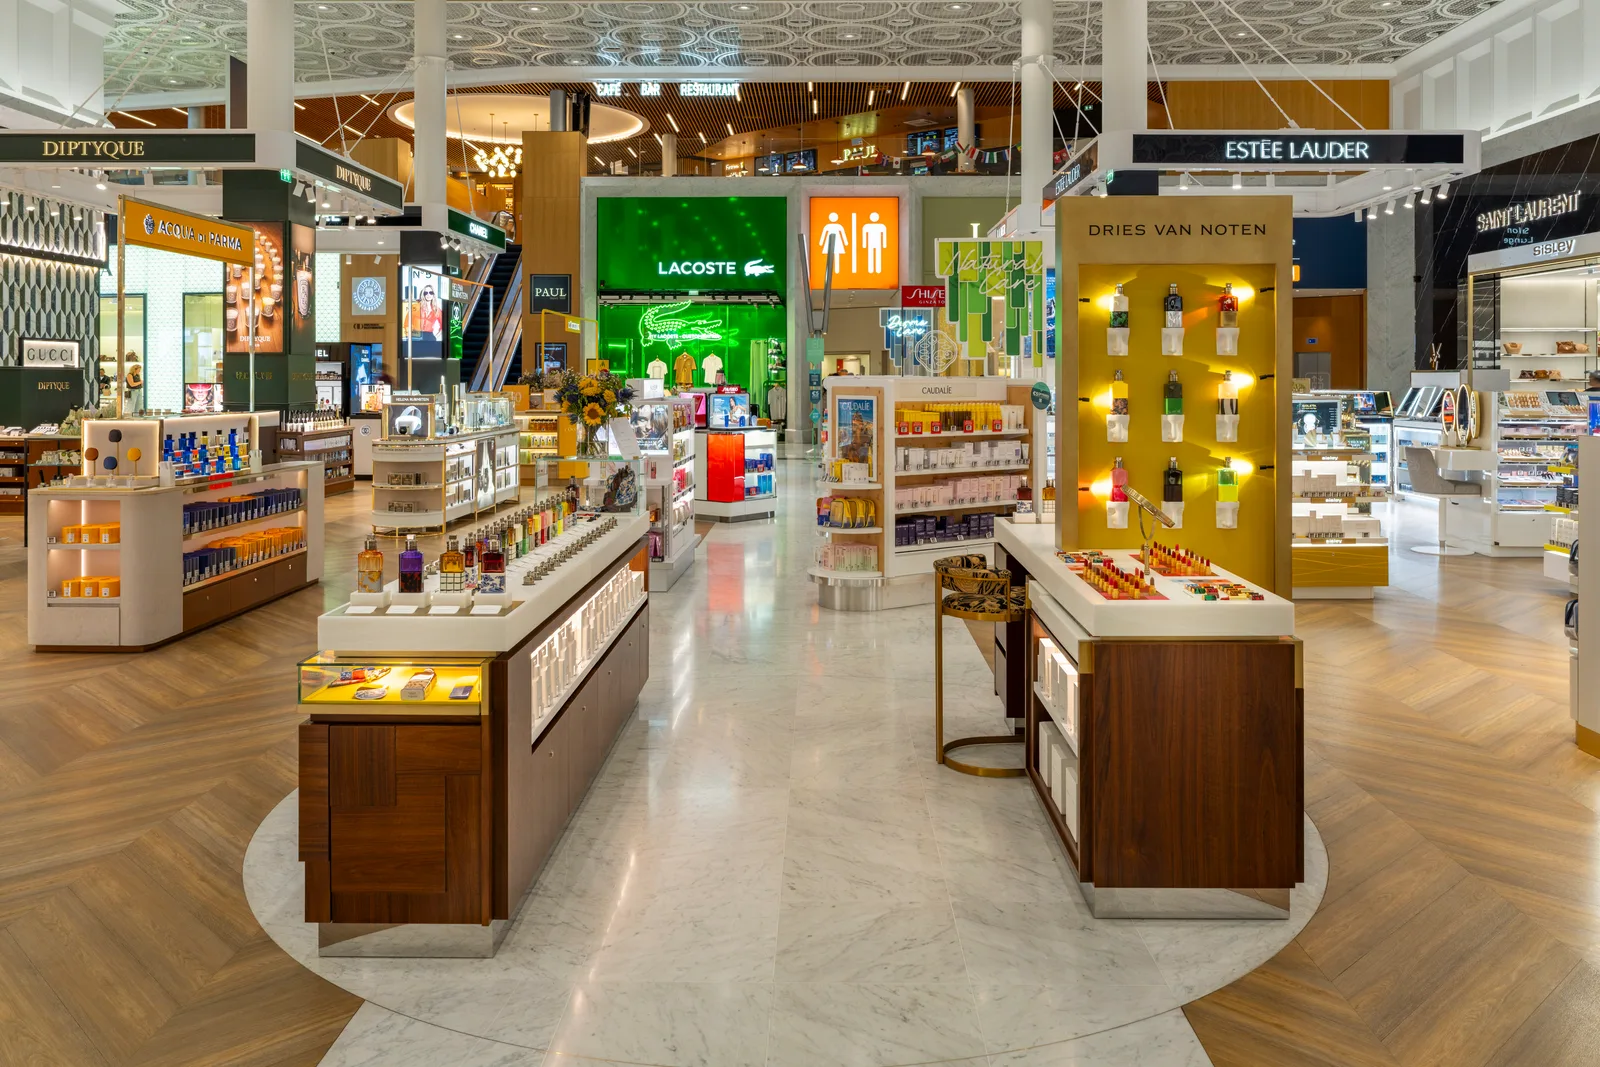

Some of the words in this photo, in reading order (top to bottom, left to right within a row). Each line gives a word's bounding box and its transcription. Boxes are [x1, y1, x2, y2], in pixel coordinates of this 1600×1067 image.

[641, 83, 660, 96] BAR
[680, 83, 739, 96] RESTAURANT
[42, 141, 145, 160] DIPTYQUE
[1290, 141, 1369, 159] LAUDER
[336, 164, 372, 191] DIPTYQUE
[1477, 207, 1513, 232] SAINT
[1515, 190, 1581, 224] LAURENT
[158, 220, 195, 240] ACQUA
[209, 231, 242, 251] PARMA
[1089, 224, 1146, 236] DRIES
[1154, 224, 1192, 236] VAN
[1201, 224, 1266, 236] NOTEN
[658, 261, 737, 275] LACOSTE
[943, 249, 1043, 274] Natural
[979, 269, 1040, 294] Care
[535, 287, 567, 297] PAUL
[906, 288, 945, 299] SHISE
[896, 327, 926, 338] Care
[27, 348, 73, 361] GUCCI
[38, 381, 71, 391] DIPTYQUE
